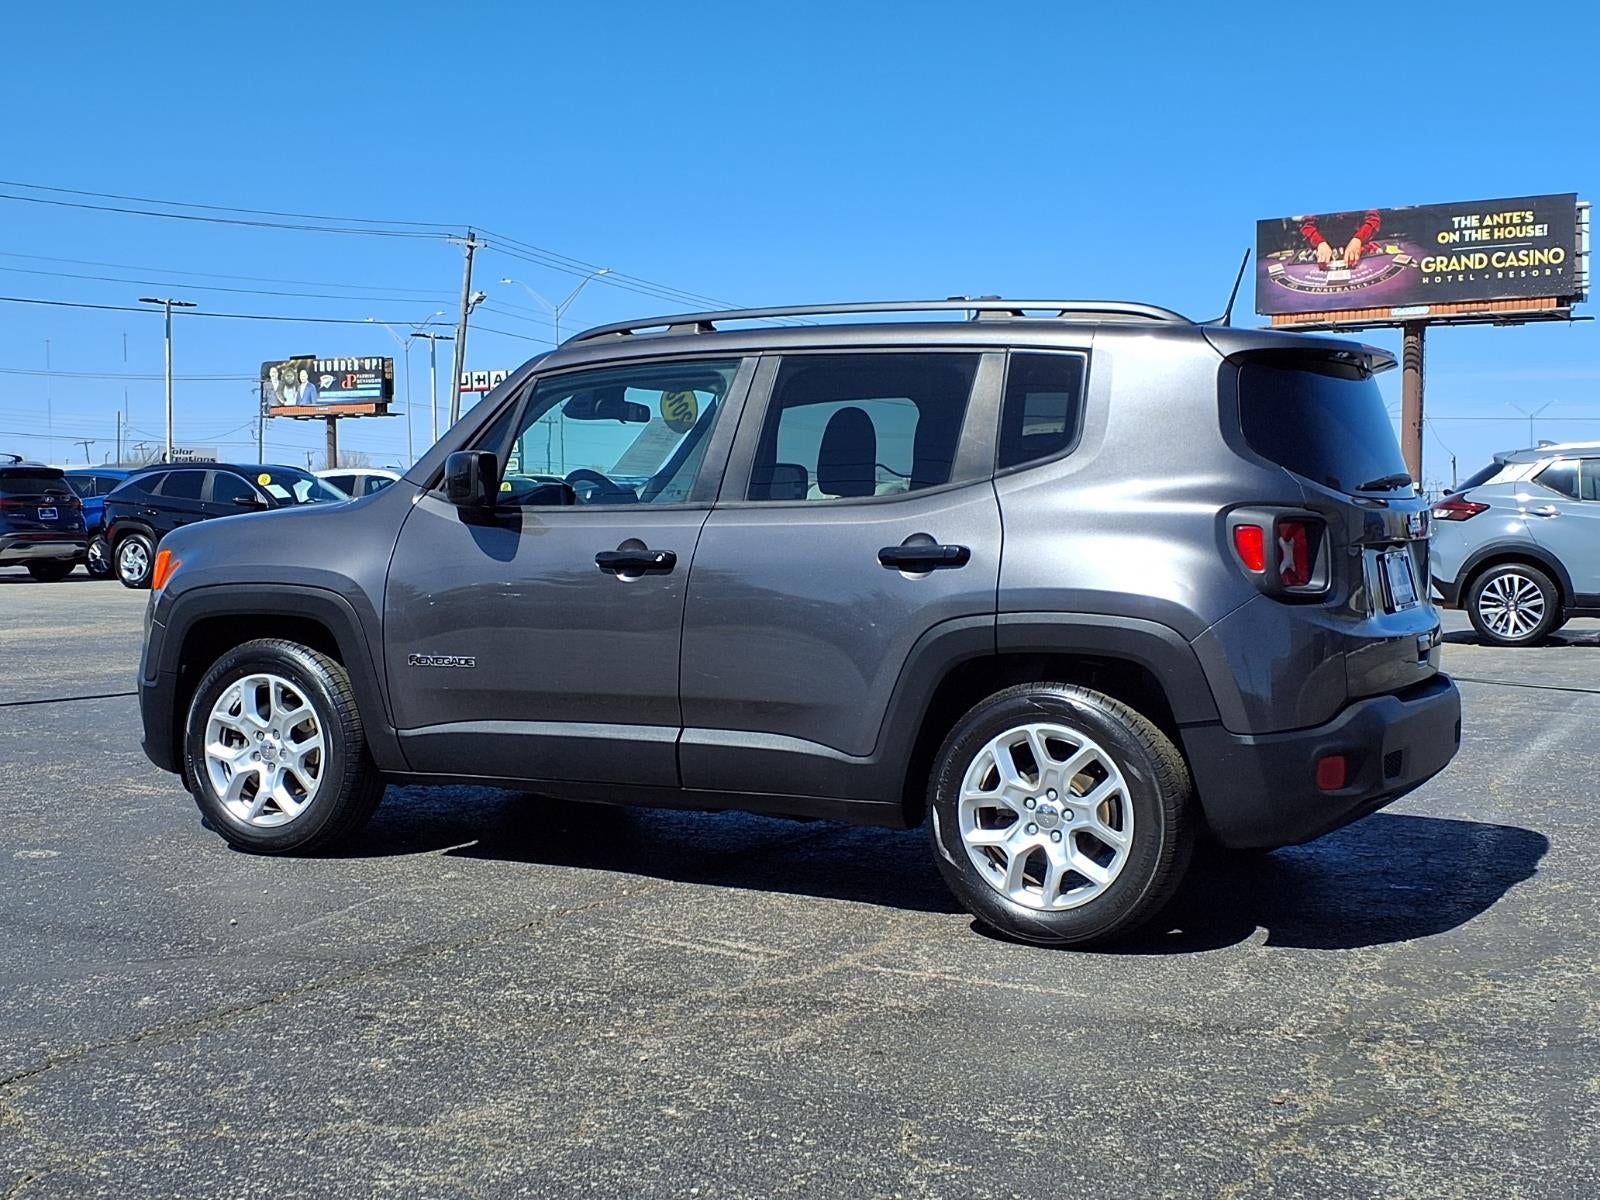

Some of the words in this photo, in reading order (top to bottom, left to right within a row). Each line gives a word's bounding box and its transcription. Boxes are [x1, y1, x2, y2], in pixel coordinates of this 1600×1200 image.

[1451, 214, 1480, 229] THE
[1482, 210, 1534, 227] ANTE'S
[1437, 230, 1460, 244] ON
[1462, 228, 1491, 242] THE
[1493, 223, 1548, 240] HOUSE!
[1420, 252, 1489, 273] GRAND
[1491, 247, 1565, 269] CASINO
[1422, 273, 1475, 284] HOTEL
[1497, 267, 1563, 279] RESORT
[313, 358, 359, 372] THUNDER
[364, 358, 382, 370] UP!
